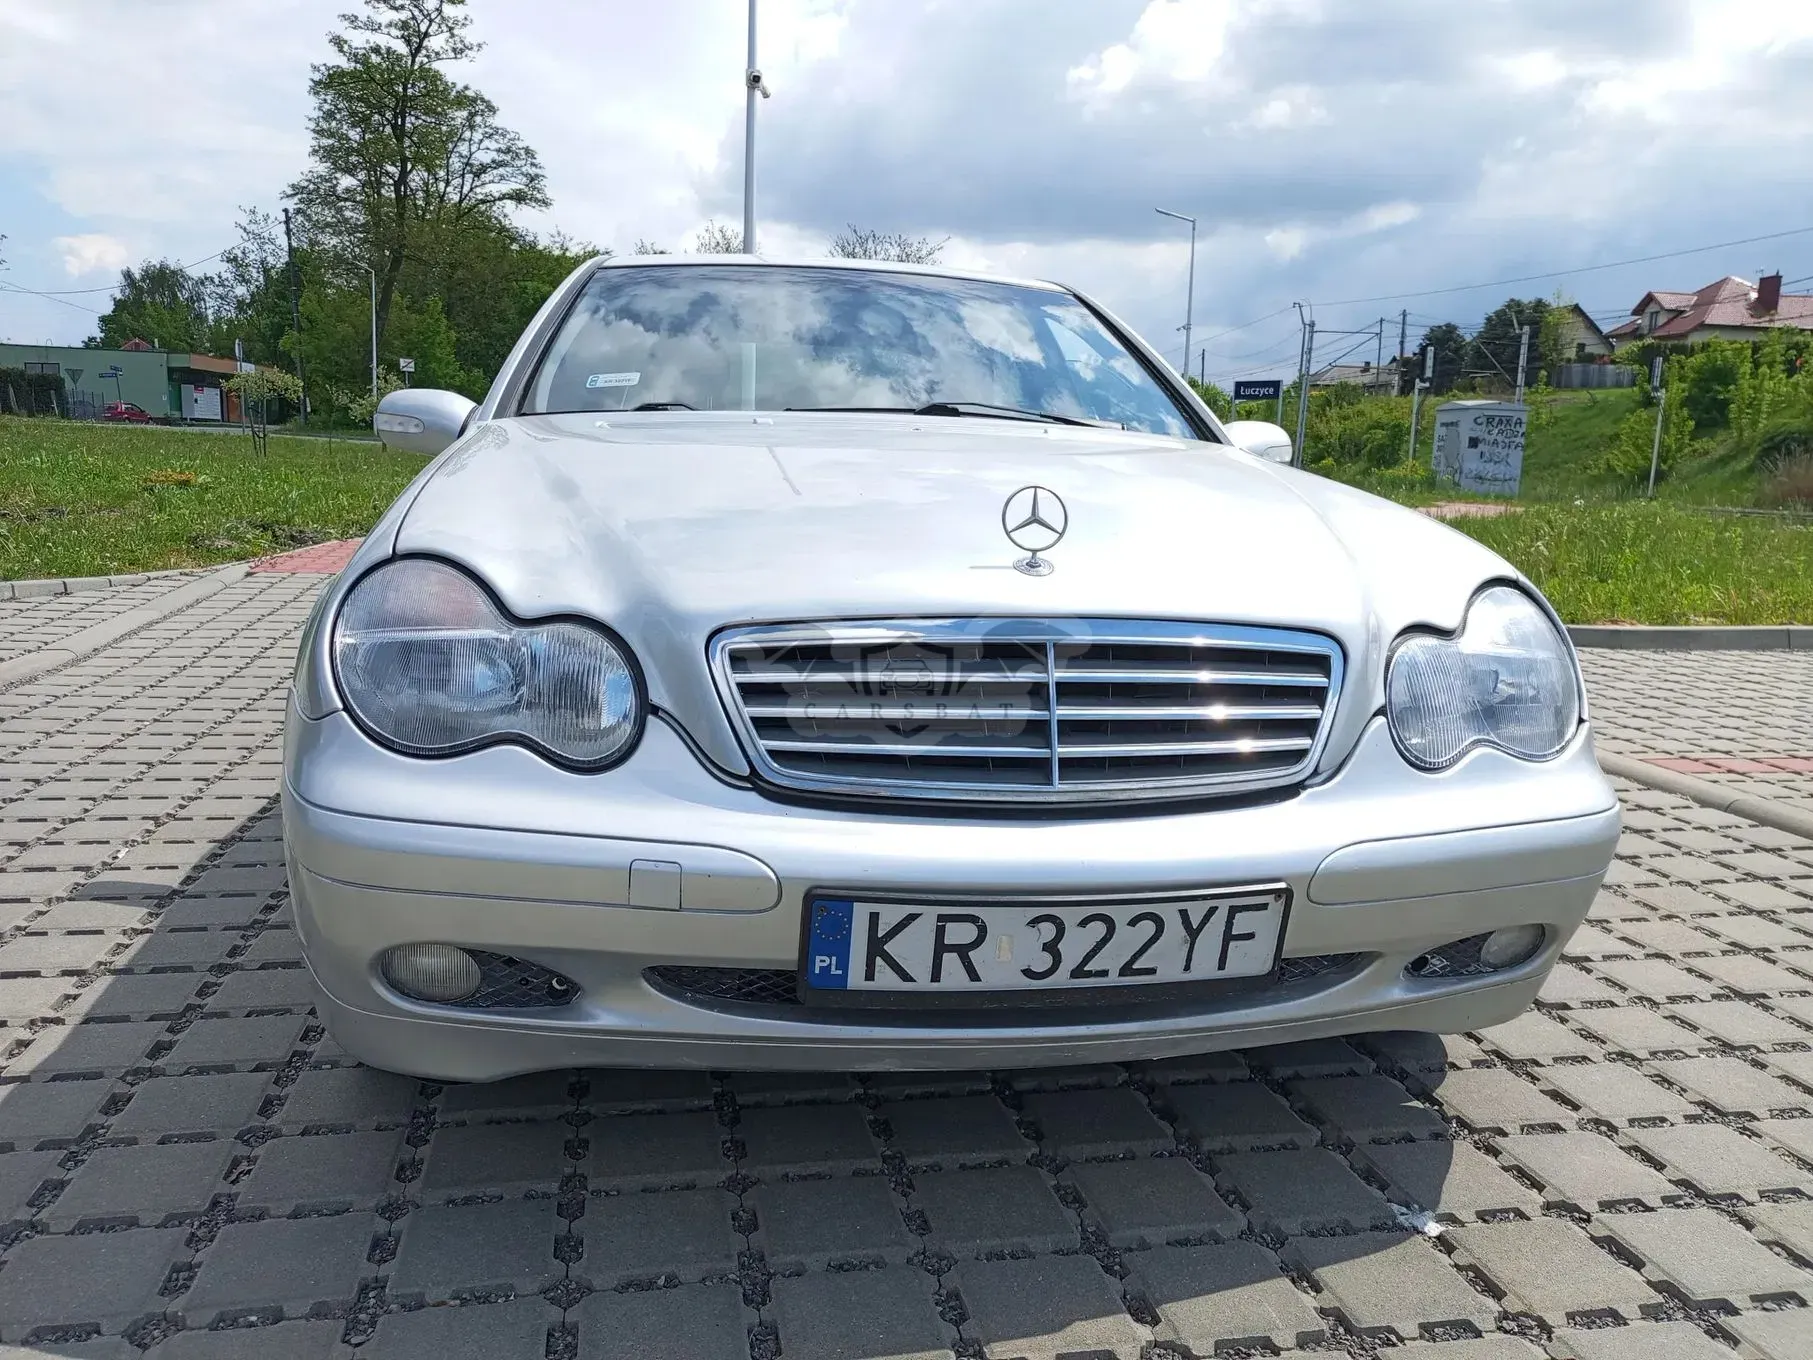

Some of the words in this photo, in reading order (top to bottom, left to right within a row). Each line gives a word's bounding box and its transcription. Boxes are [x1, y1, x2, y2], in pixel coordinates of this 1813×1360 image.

[1240, 386, 1274, 397] Łuczyce
[863, 911, 988, 983] KR
[1020, 902, 1270, 981] 322YF
[814, 955, 843, 975] PL
